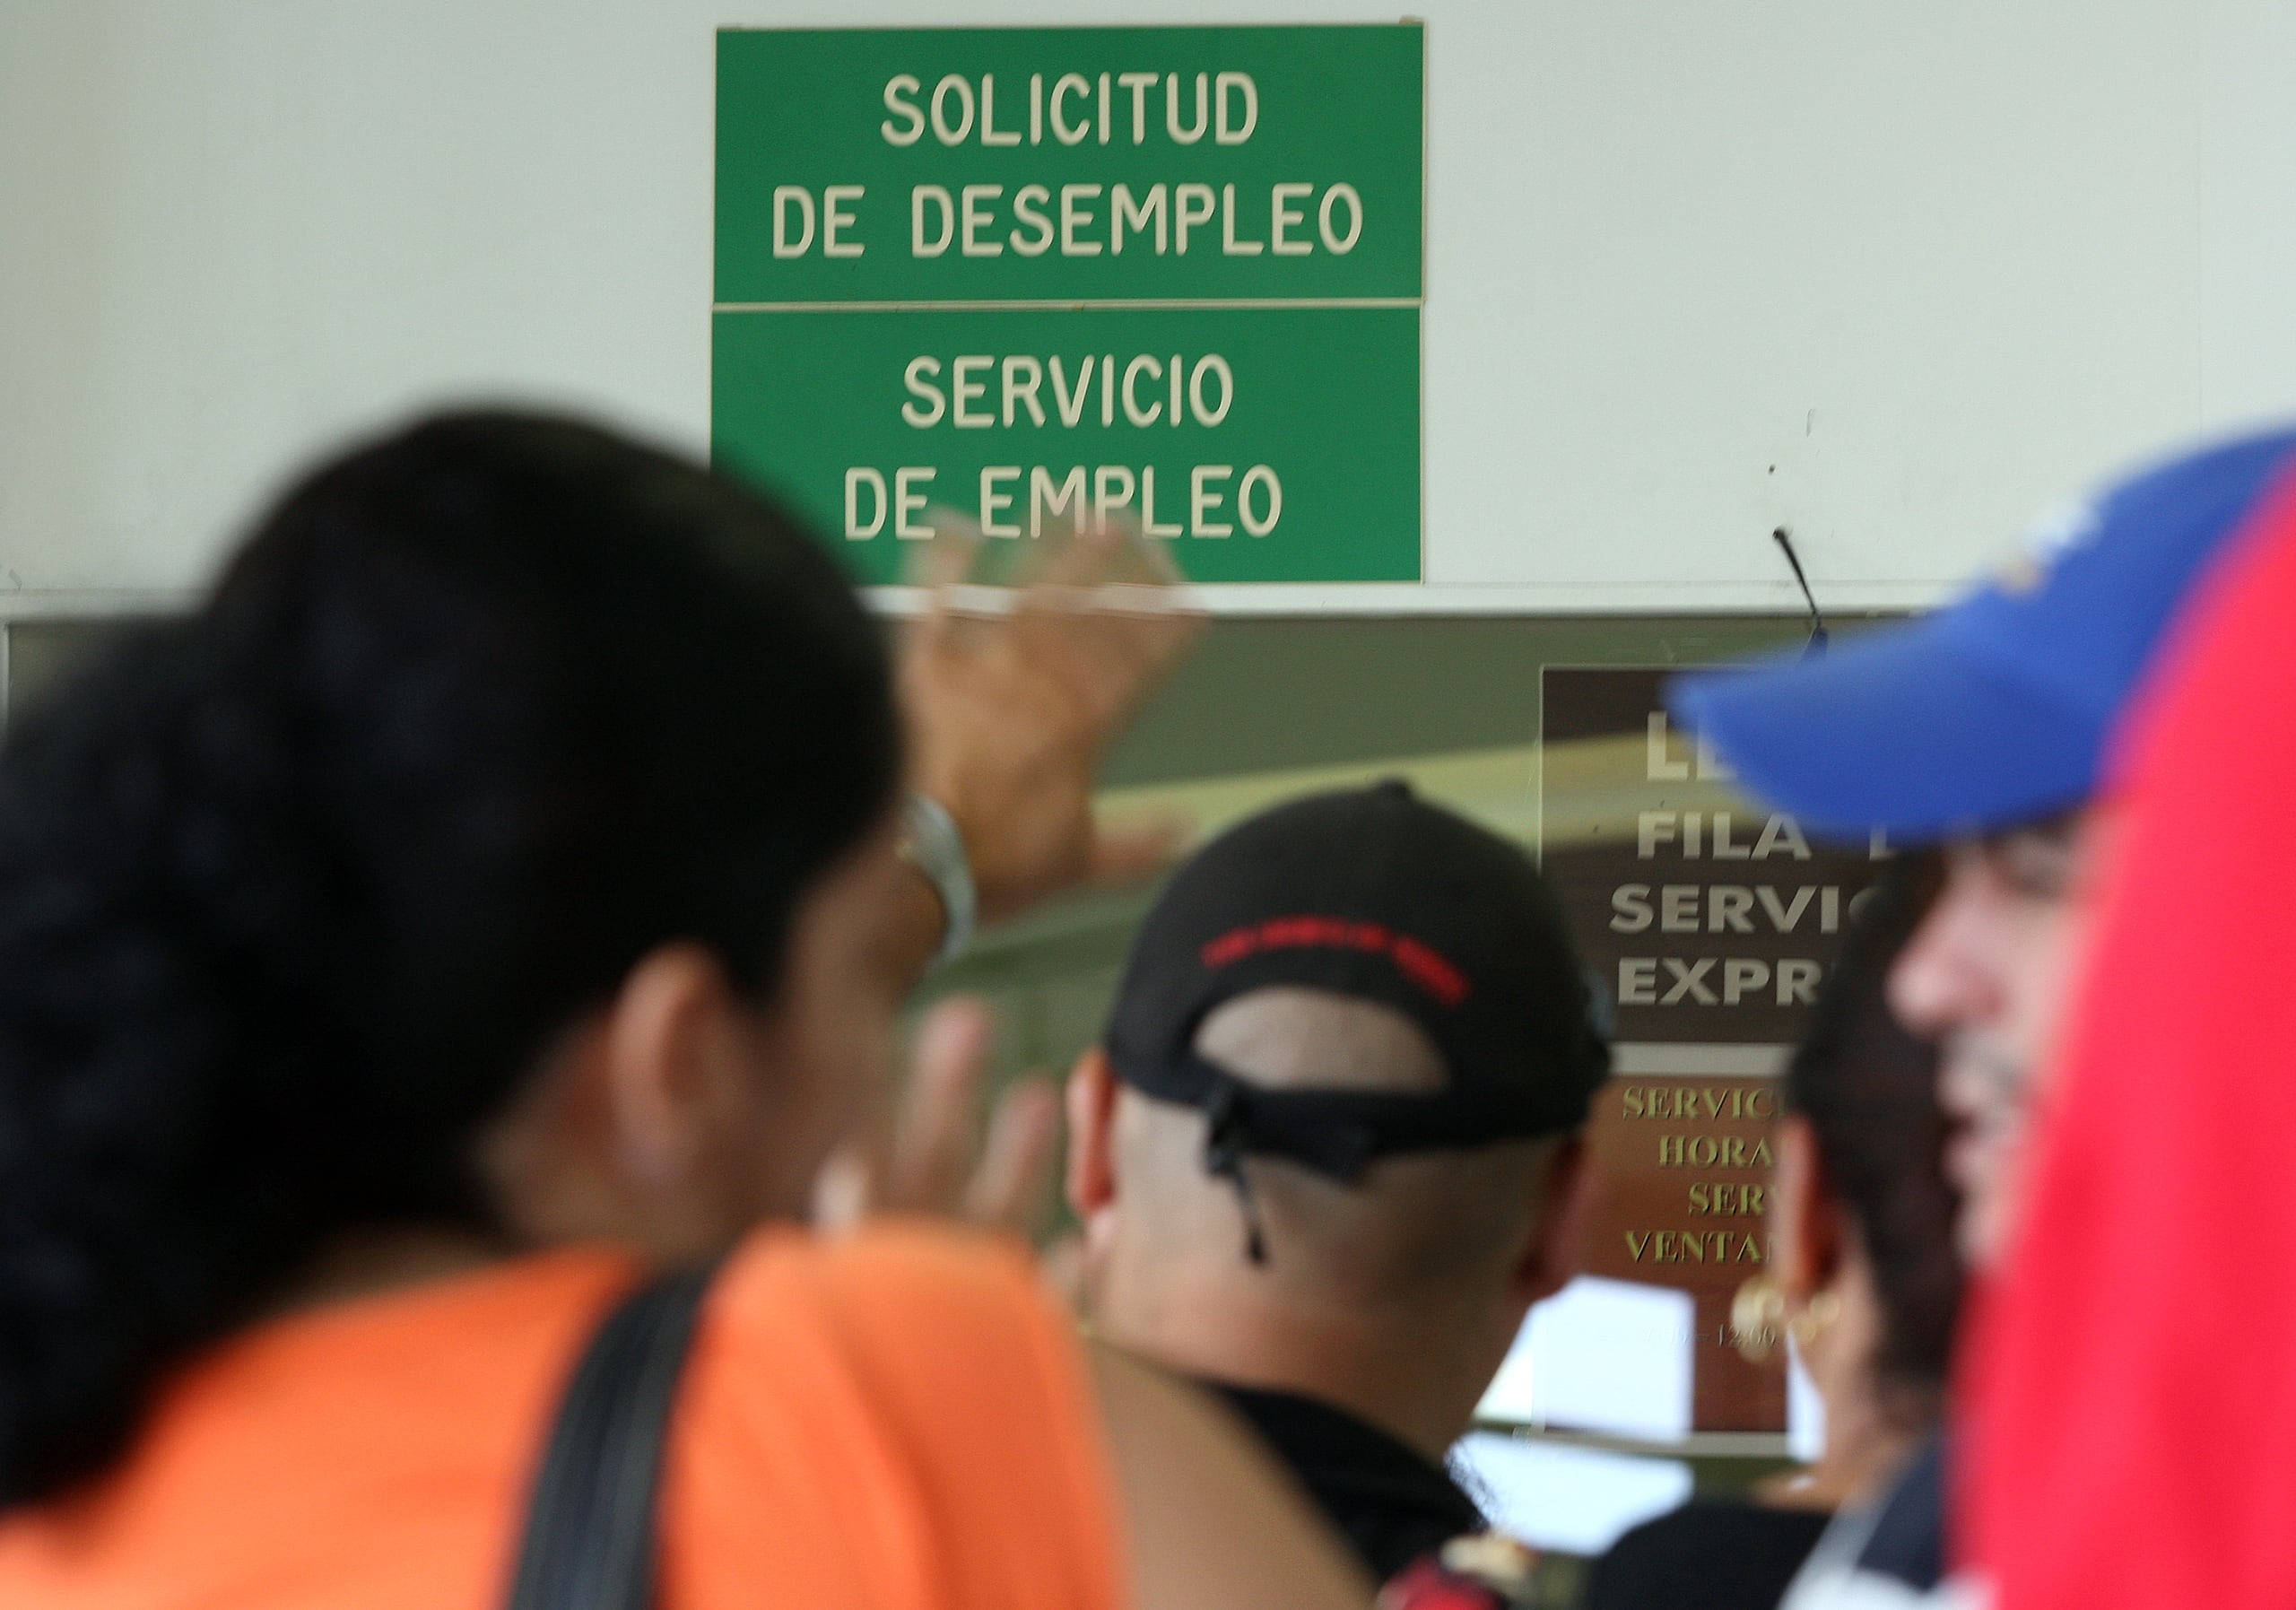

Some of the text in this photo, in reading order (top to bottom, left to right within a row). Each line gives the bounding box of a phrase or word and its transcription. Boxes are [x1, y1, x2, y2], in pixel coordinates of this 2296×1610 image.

[882, 72, 1258, 146] SOLICITUD
[773, 182, 1363, 258] DE DESEMPLEO
[901, 353, 1234, 429] SERVICIO
[845, 464, 1283, 540] DE EMPLEO
[1638, 811, 1812, 861] FILA
[1618, 957, 1837, 1006] EXPR
[1688, 1183, 1780, 1215] SER
[1624, 1231, 1774, 1263] VENTA
